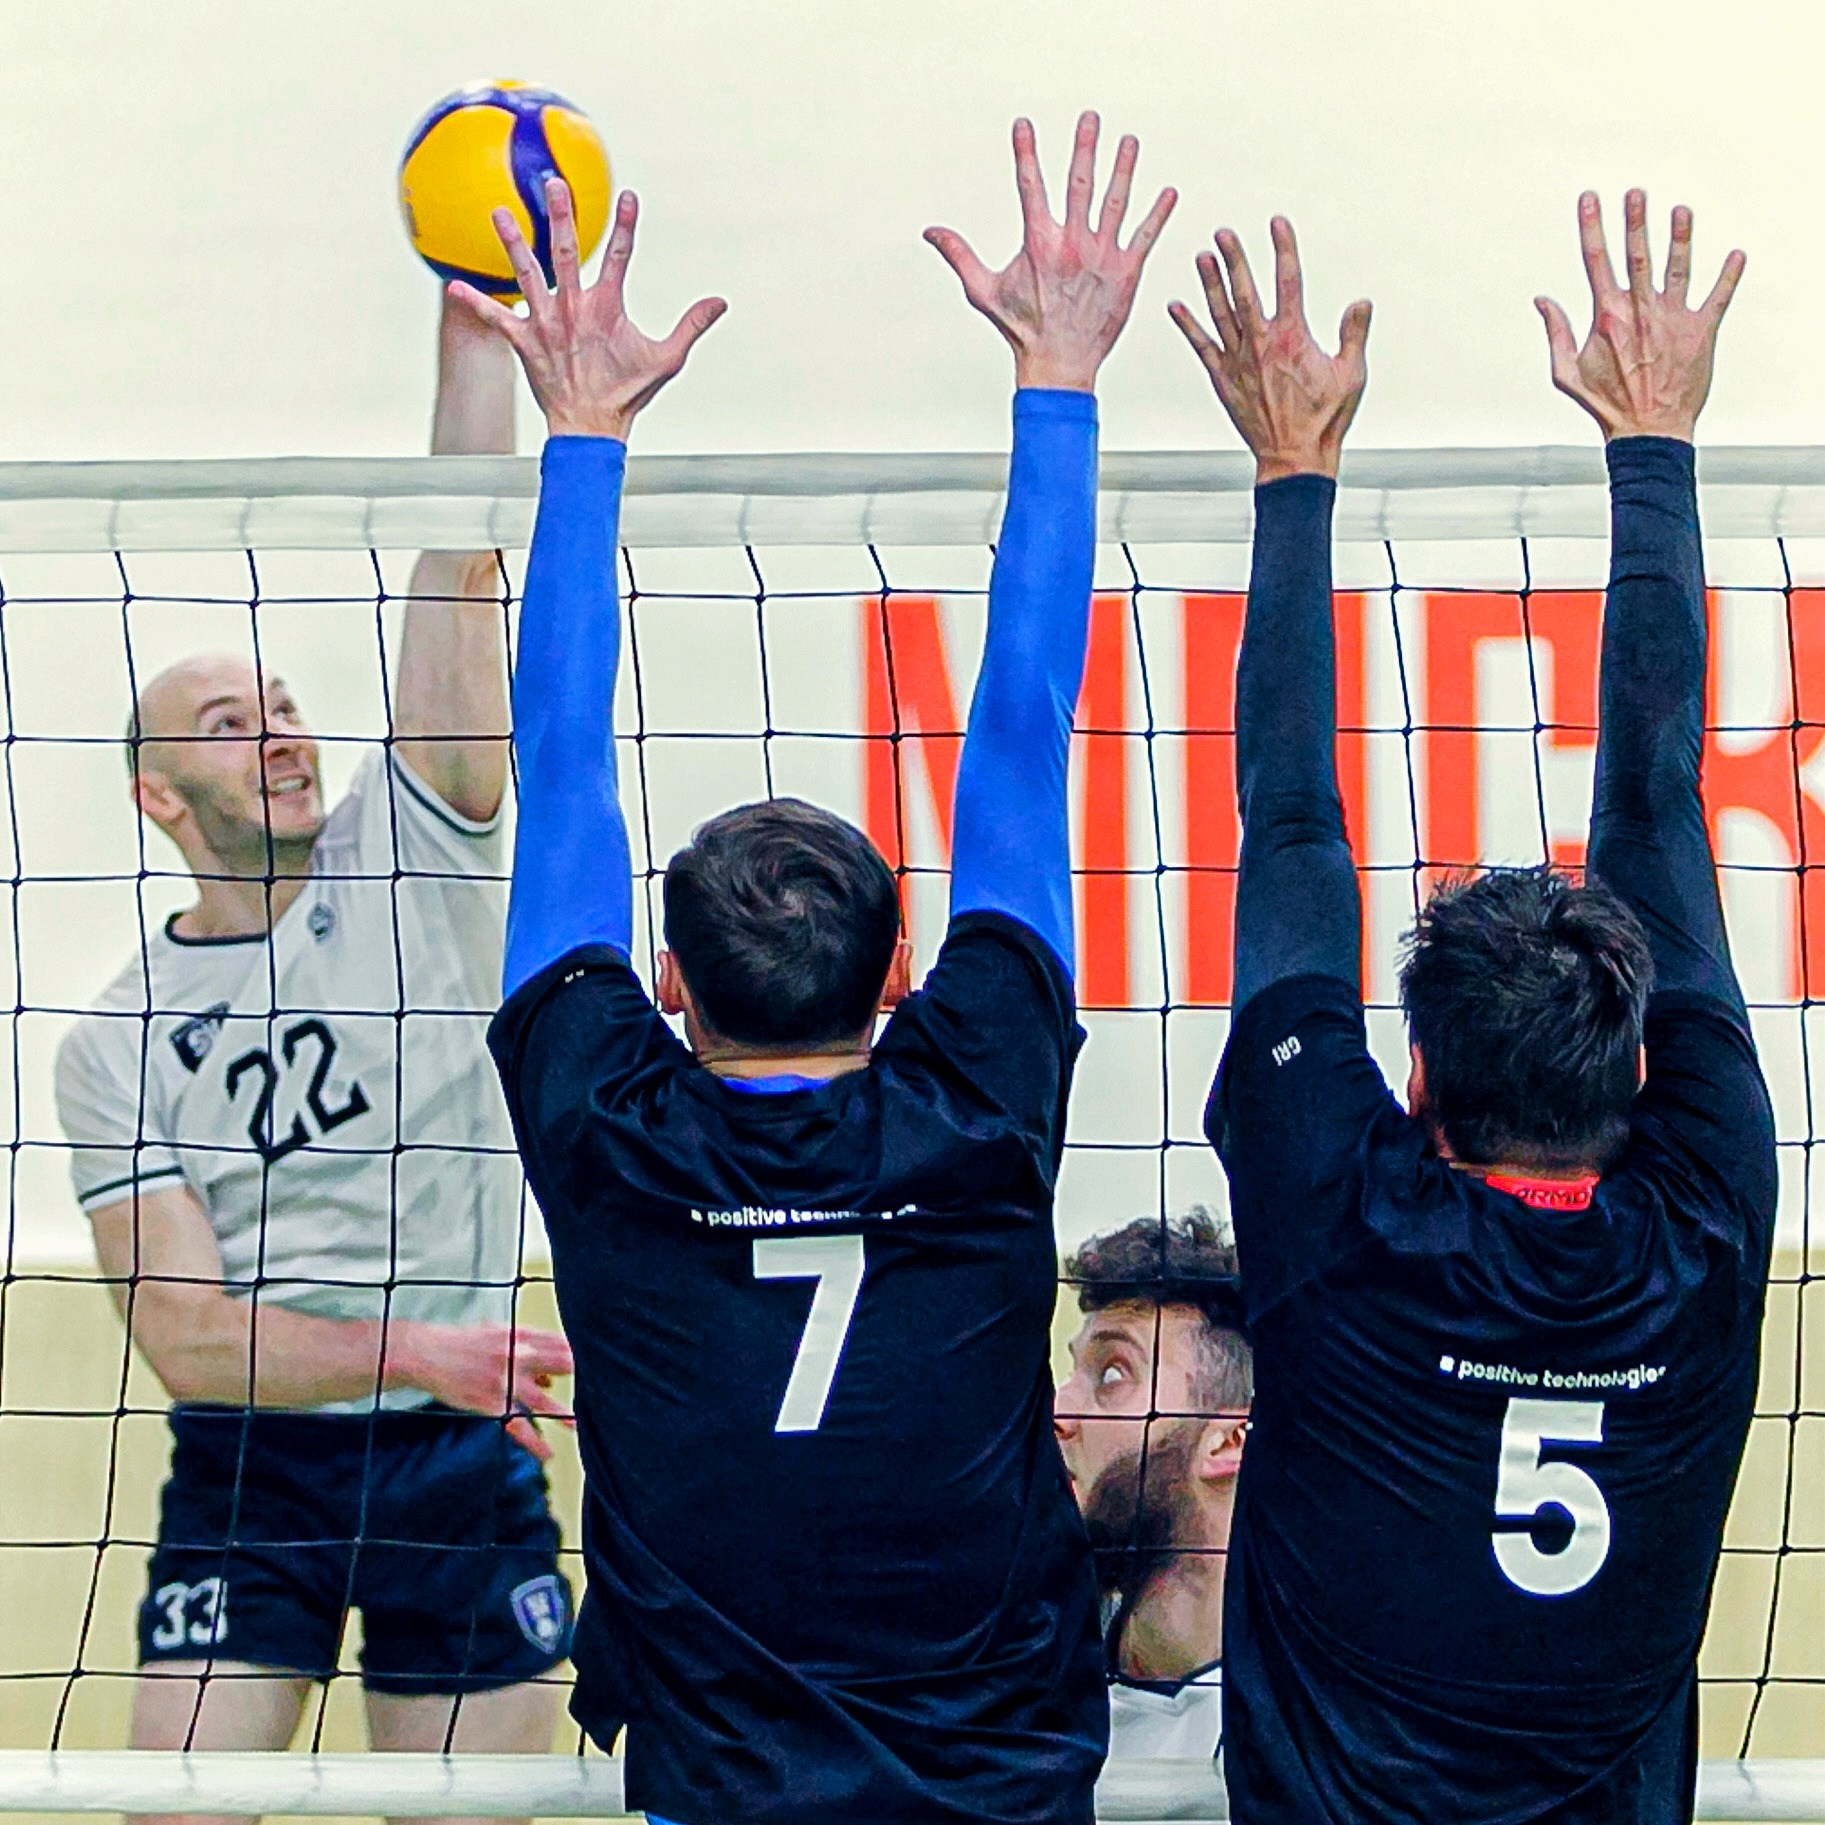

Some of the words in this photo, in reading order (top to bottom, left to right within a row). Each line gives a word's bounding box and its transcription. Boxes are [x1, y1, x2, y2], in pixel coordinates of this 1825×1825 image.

[226, 1018, 370, 1161] 22
[708, 1206, 786, 1227] positive
[753, 1235, 865, 1432] 7
[1458, 1360, 1539, 1386] positive
[1492, 1397, 1610, 1595] 5
[153, 1577, 228, 1650] 33
